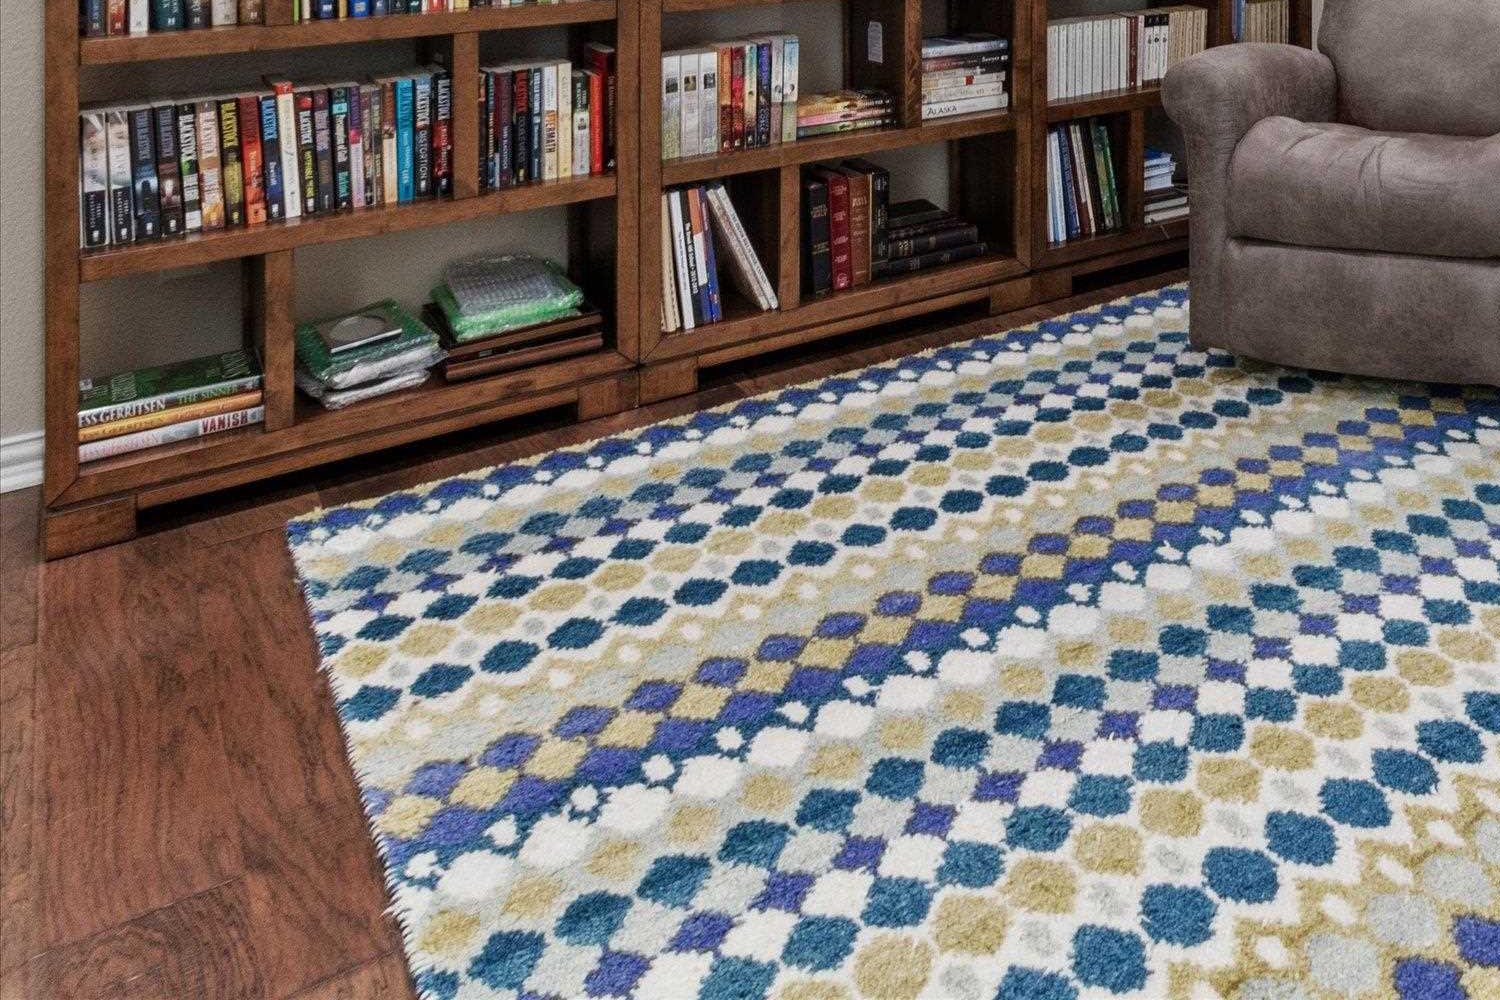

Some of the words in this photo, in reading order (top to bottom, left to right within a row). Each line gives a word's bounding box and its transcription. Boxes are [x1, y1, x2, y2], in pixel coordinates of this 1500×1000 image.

[416, 85, 430, 126] BLACKSTOCK
[438, 79, 450, 120] BLACKSTOCK
[927, 105, 958, 117] ALASKA
[179, 114, 198, 160] BLACKSTOCK
[221, 102, 237, 149] BLACKSTOCK
[263, 100, 277, 140] BLACKSTOCK
[299, 111, 313, 144] BLACKSTOCK
[419, 130, 429, 179] DISTORTION
[99, 399, 167, 422] GERRITSEN
[202, 411, 249, 433] VANISH
